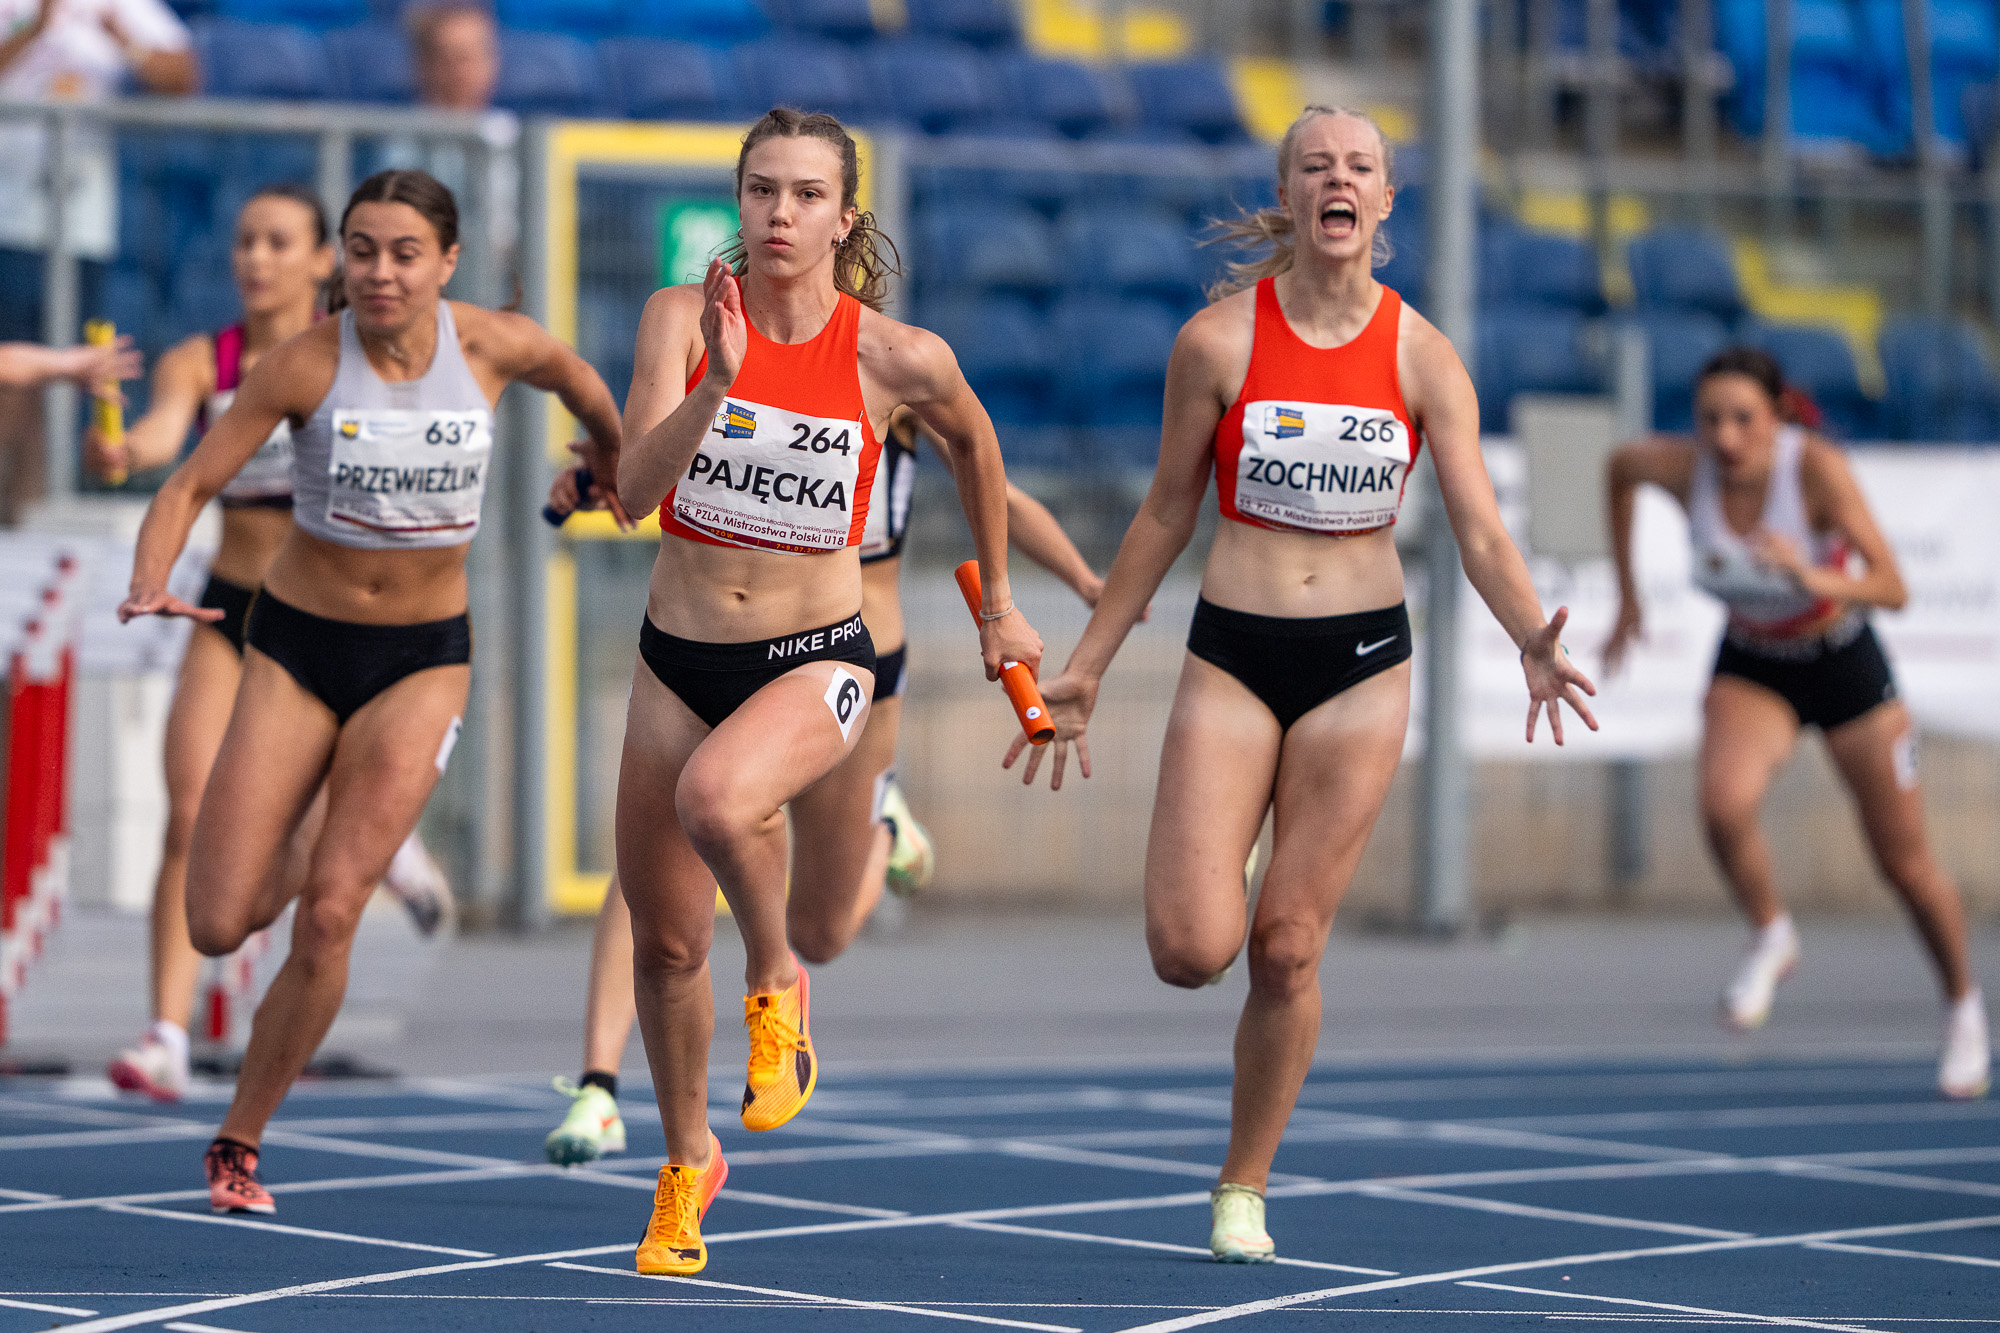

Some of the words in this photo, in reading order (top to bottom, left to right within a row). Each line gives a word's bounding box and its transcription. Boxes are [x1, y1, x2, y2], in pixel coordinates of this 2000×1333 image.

[425, 421, 476, 445] 637
[788, 423, 851, 457] 264
[1339, 415, 1395, 442] 266
[688, 452, 847, 512] PAJĘCKA
[1247, 457, 1397, 493] ZOCHNIAK
[677, 503, 692, 516] 55.
[695, 508, 720, 524] PZLA
[723, 516, 787, 539] Mistrzostwa
[790, 531, 821, 543] Polski
[824, 535, 845, 546] U18
[678, 496, 691, 504] XXIX
[692, 500, 733, 515] Ogólnopolska
[733, 510, 766, 523] Olimpiada
[803, 525, 821, 533] lekkiej
[1257, 502, 1280, 515] PZLA
[1283, 510, 1343, 525] Mistrzostwa
[1346, 516, 1374, 525] Polski
[768, 632, 824, 660] NIKE
[830, 616, 861, 646] PRO
[836, 678, 860, 724] 6
